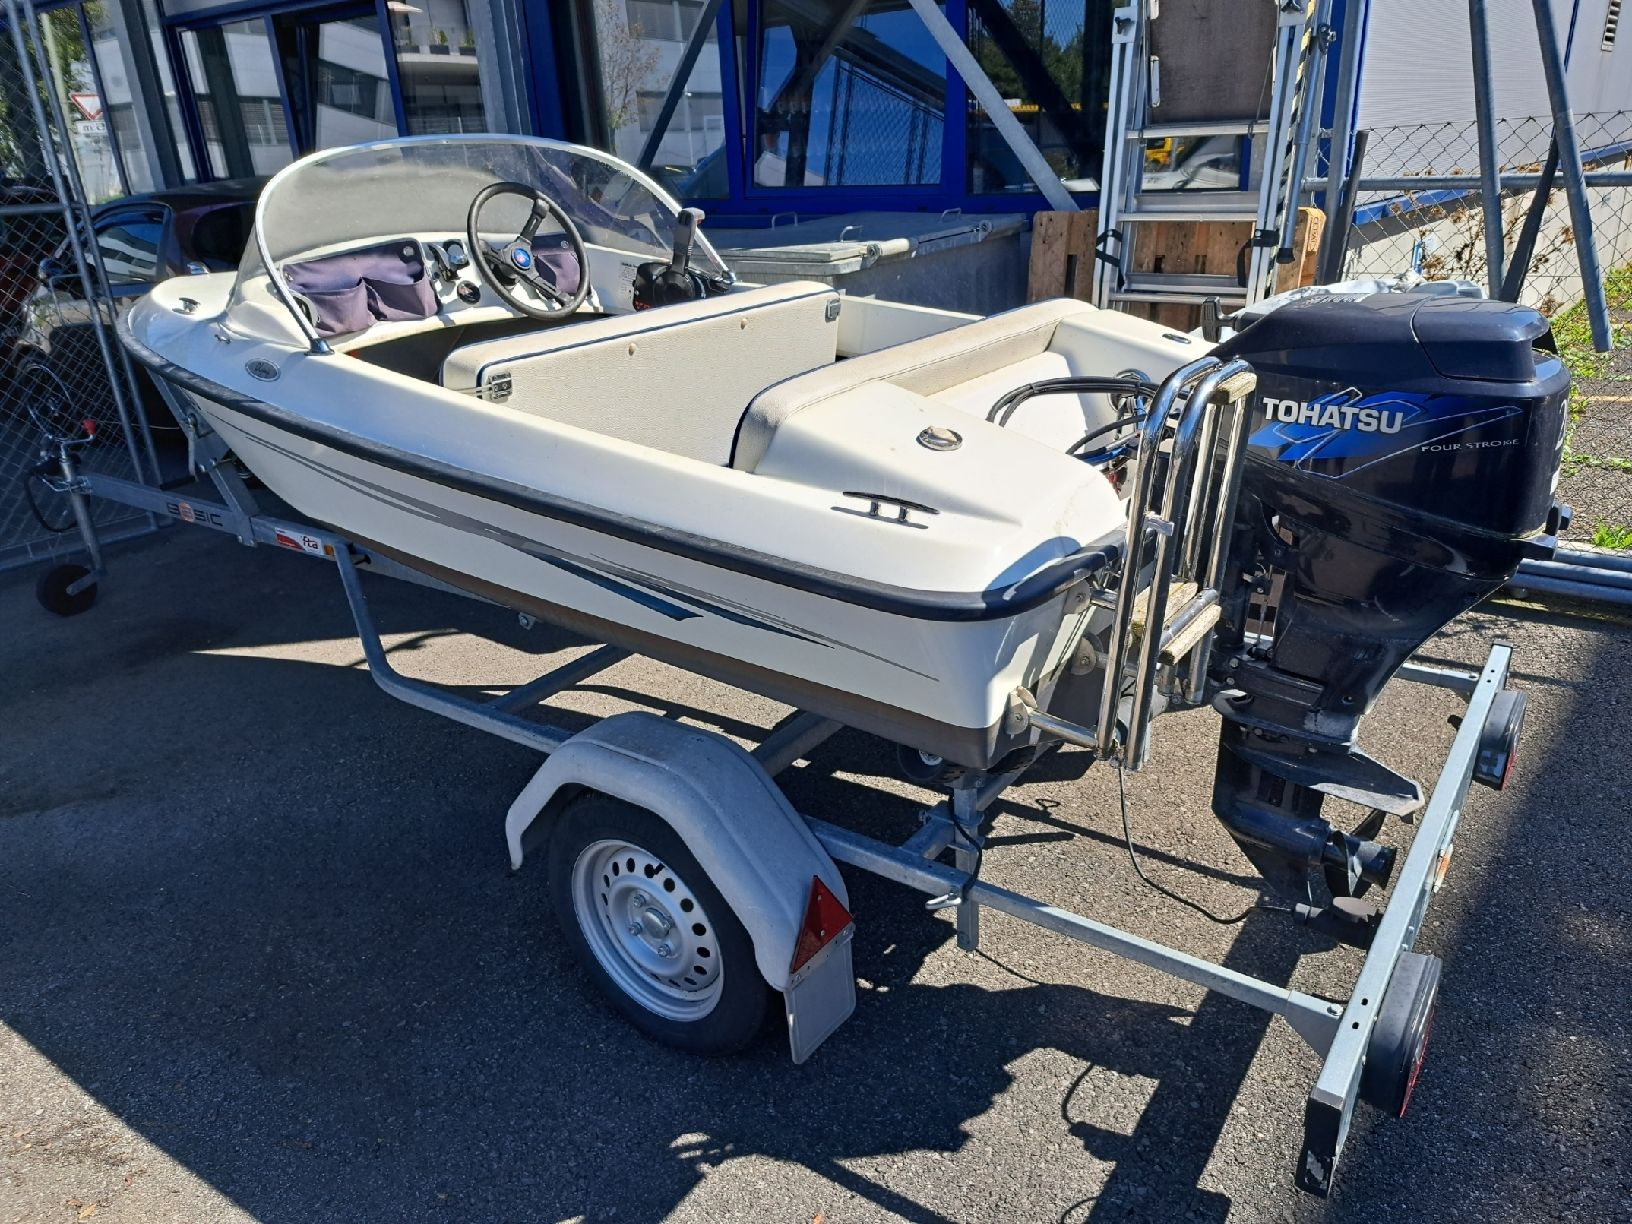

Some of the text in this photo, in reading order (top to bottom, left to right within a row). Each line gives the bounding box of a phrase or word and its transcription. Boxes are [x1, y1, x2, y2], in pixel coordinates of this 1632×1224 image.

[1263, 397, 1403, 434] TOHATSU
[1421, 443, 1462, 452] FOUR
[167, 502, 224, 527] BSIC
